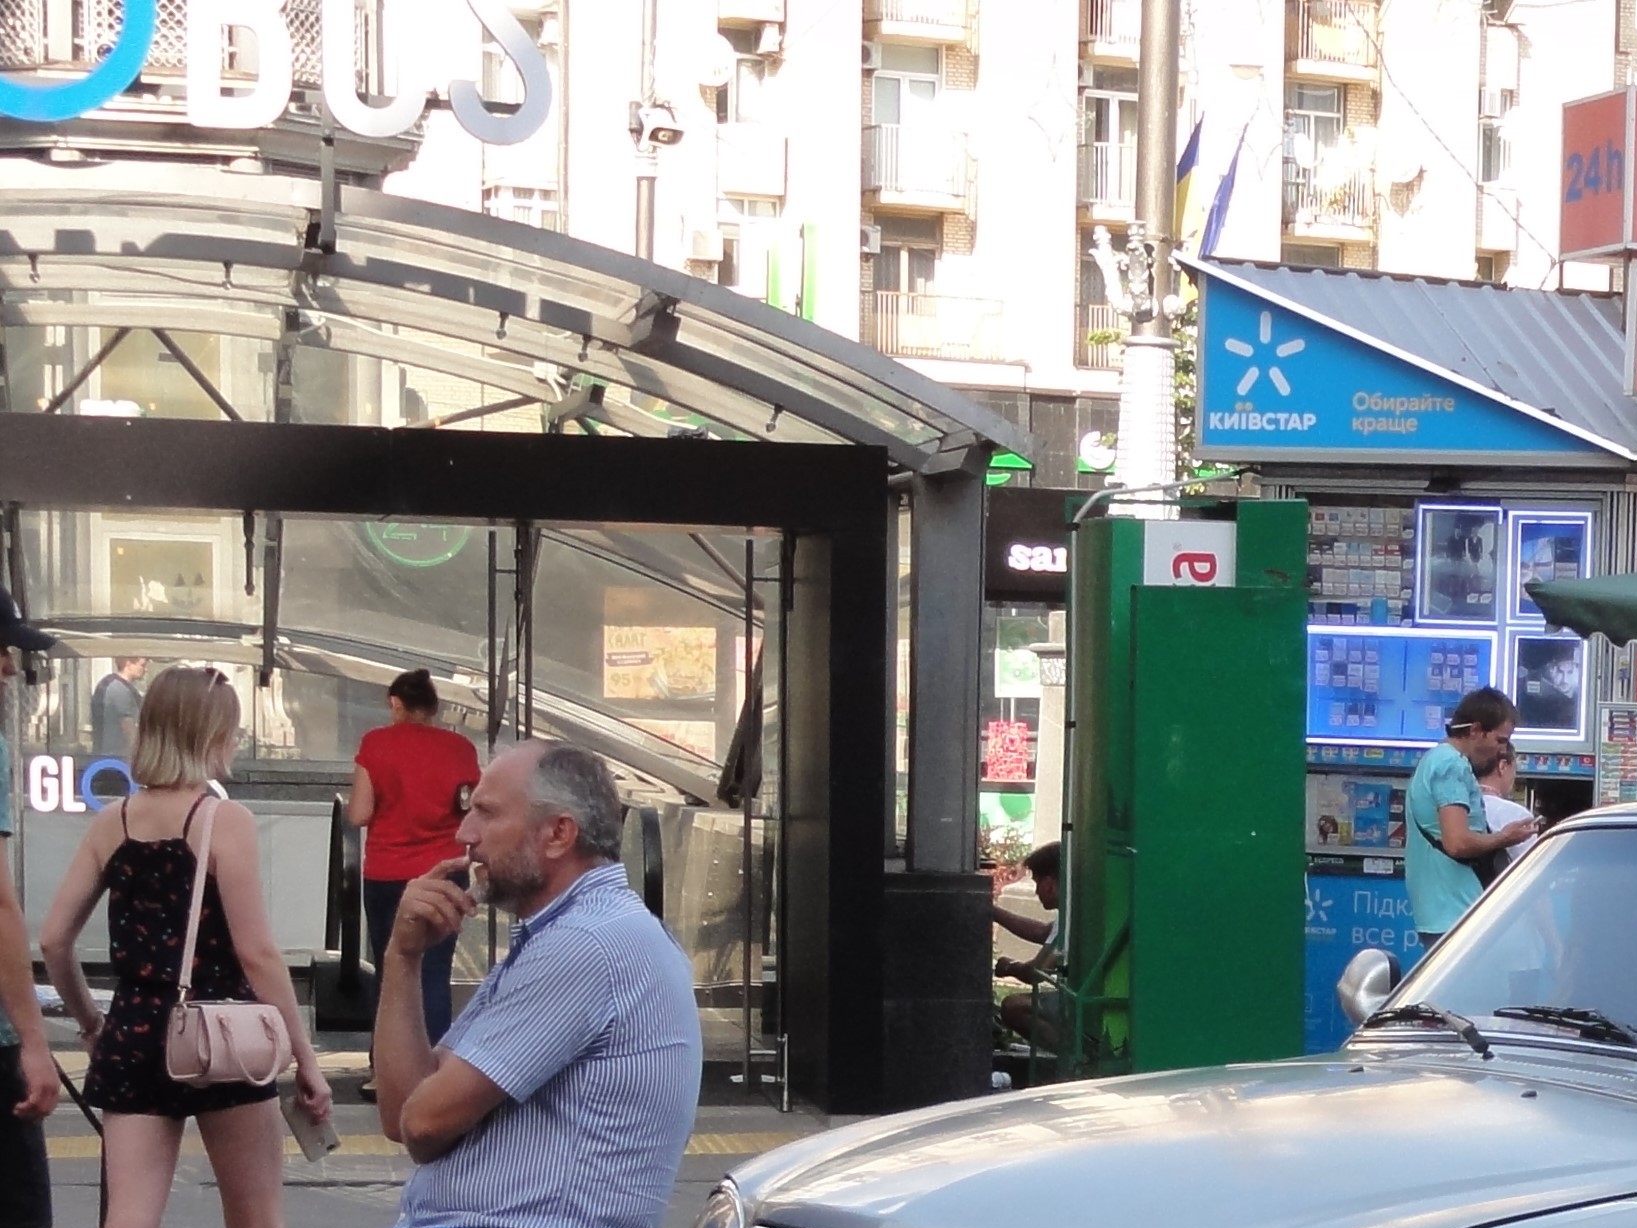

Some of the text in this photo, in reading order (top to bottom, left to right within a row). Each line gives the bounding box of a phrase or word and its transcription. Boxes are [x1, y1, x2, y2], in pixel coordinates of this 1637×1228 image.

[0, 0, 552, 146] BUS
[1352, 391, 1456, 415] Обирайте
[1209, 401, 1317, 430] КИЇВСТАР
[1352, 417, 1419, 435] краще
[1351, 927, 1395, 946] все
